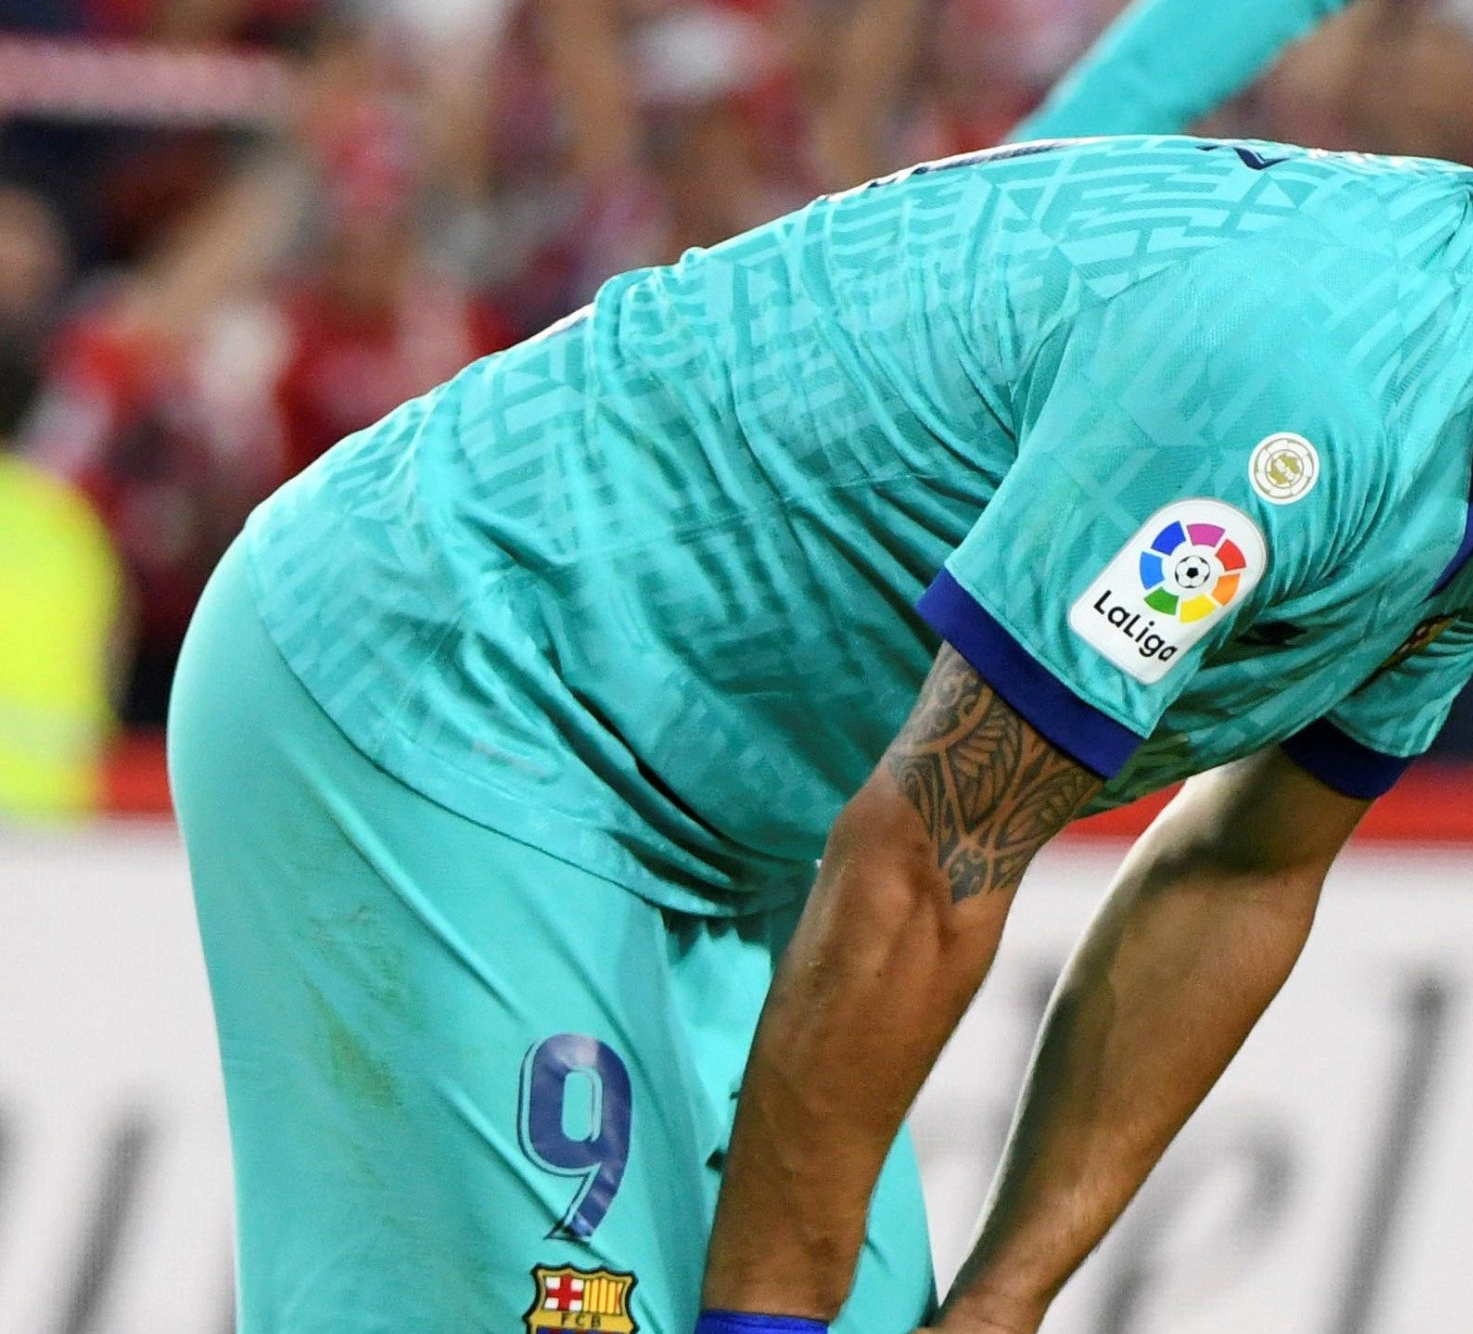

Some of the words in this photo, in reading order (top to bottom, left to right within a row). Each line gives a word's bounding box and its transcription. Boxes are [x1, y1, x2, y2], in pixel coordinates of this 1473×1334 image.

[1093, 589, 1179, 663] LaLiga
[517, 1032, 633, 1244] 9
[560, 1313, 601, 1329] FCB
